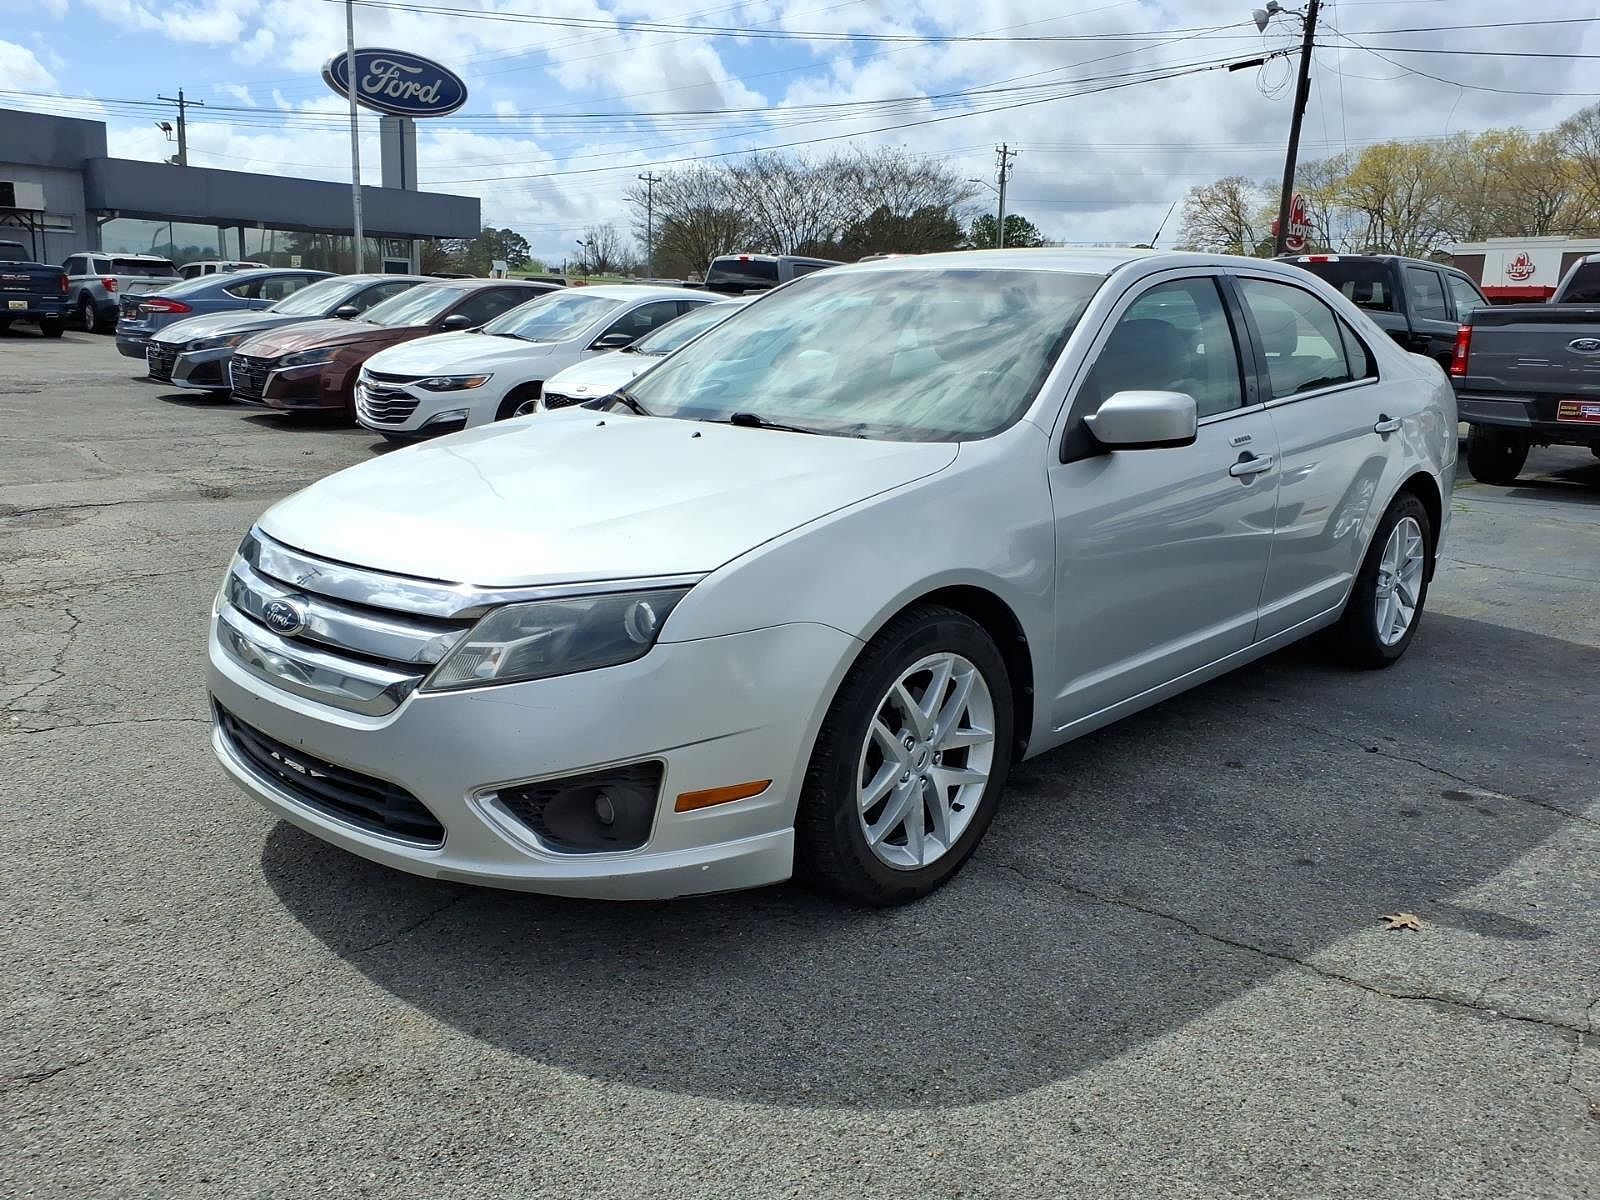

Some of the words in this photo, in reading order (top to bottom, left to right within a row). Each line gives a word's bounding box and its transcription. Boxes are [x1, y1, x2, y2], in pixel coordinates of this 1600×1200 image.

[361, 58, 442, 104] Ford
[1505, 263, 1536, 274] Arby's
[1576, 340, 1598, 350] Ford
[266, 602, 292, 627] Ford
